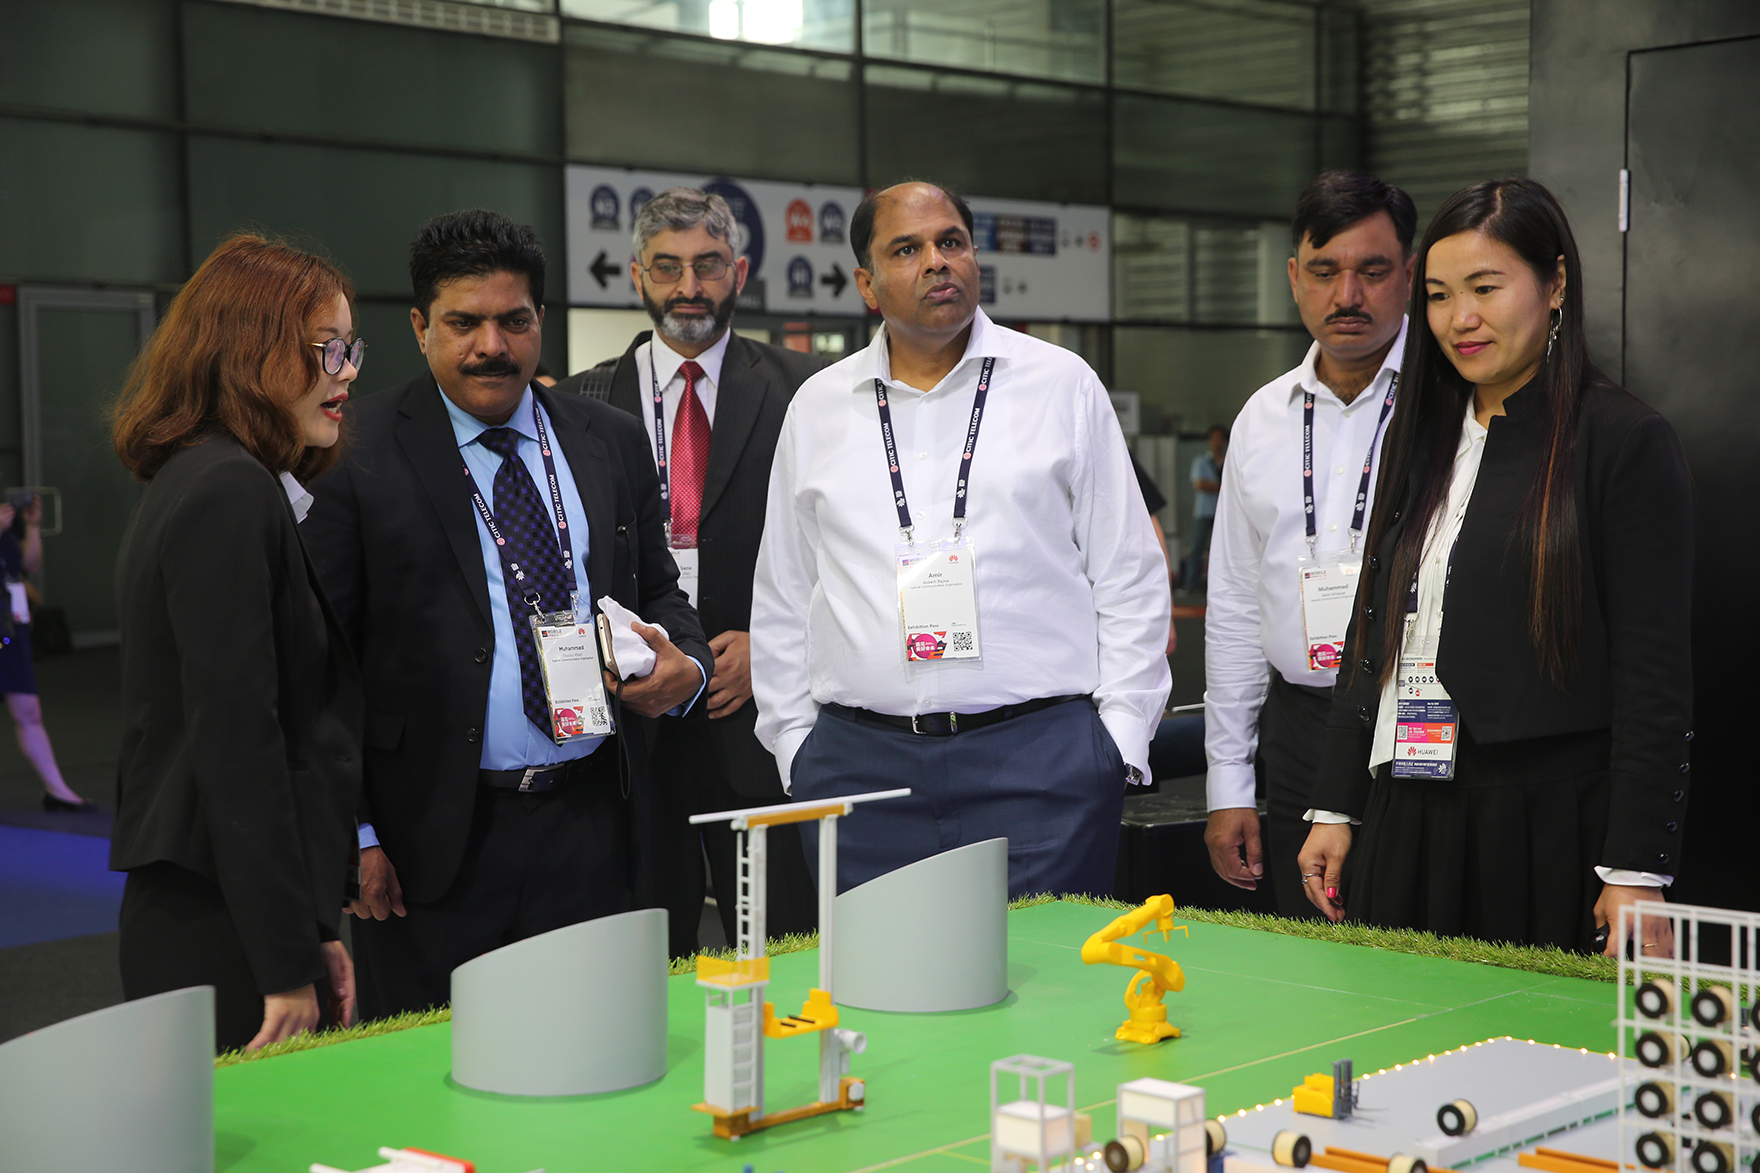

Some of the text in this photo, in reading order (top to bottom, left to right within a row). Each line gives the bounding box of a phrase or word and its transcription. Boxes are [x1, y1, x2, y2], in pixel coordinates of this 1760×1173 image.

[535, 408, 549, 450] CITIC TELECOM
[884, 422, 893, 449] TELECOM
[966, 408, 980, 452] CITIC TELECOM
[473, 493, 500, 539] CITIC TELECOM
[550, 474, 563, 521] CITIC TELECOM
